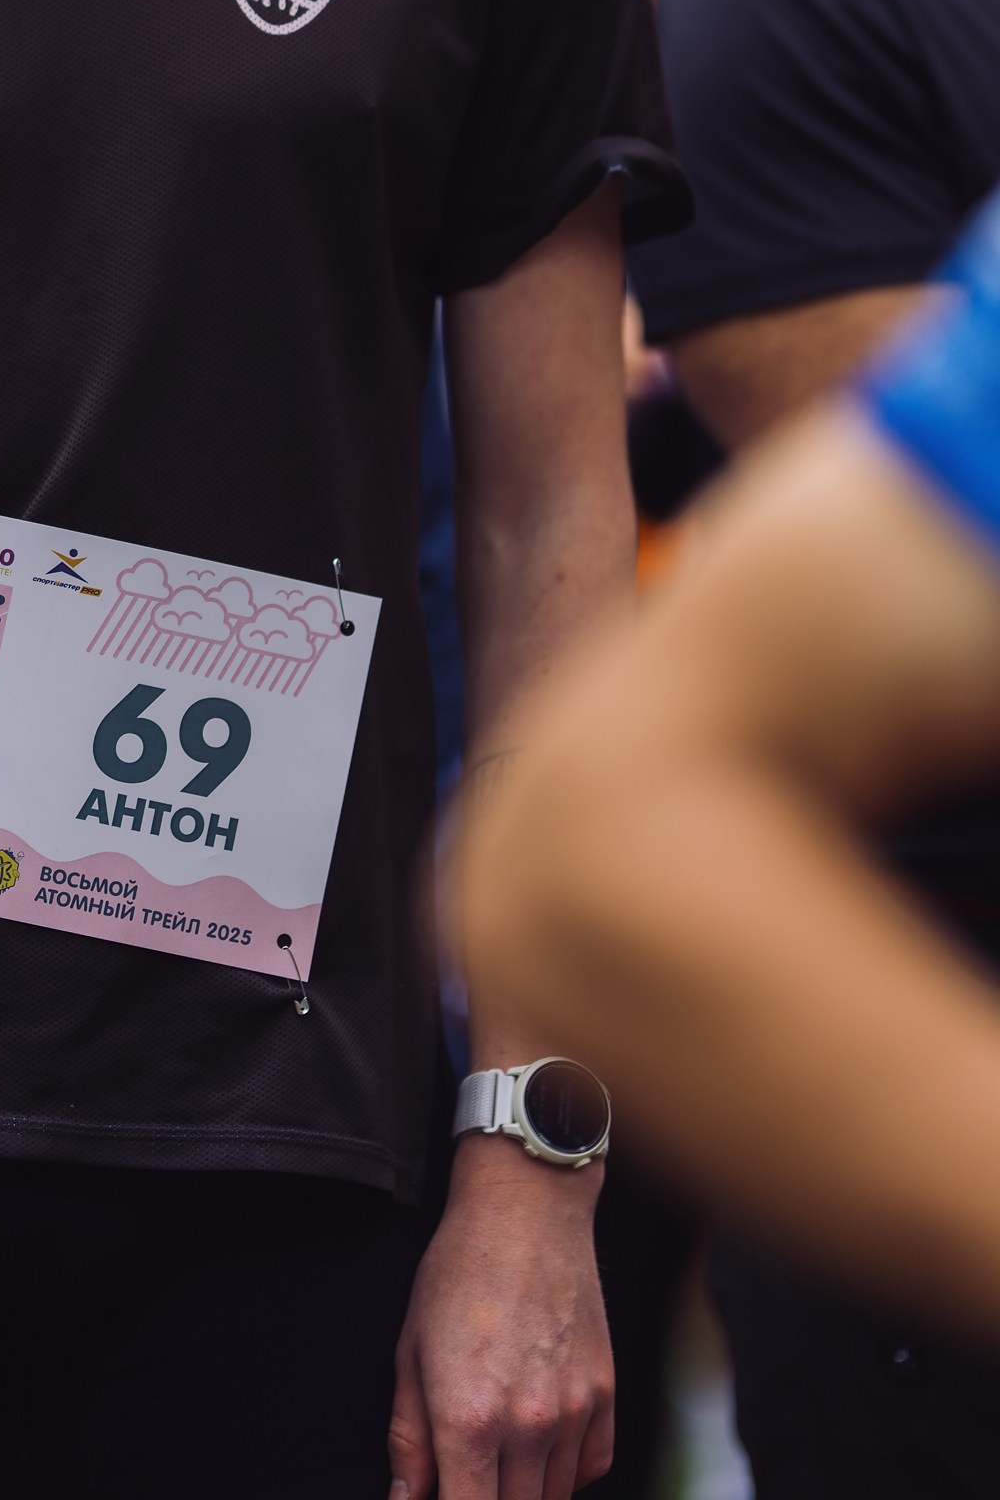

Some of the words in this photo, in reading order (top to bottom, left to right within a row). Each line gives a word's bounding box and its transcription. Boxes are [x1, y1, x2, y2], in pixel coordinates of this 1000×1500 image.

[80, 586, 101, 596] PRO
[92, 683, 252, 797] 69
[75, 788, 239, 851] АНТОН
[40, 865, 139, 900] ВОСЬМОЙ
[34, 887, 136, 921] АТОМНЫЙ
[142, 908, 201, 935] ТРЕЙЛ
[206, 922, 252, 946] 2025
